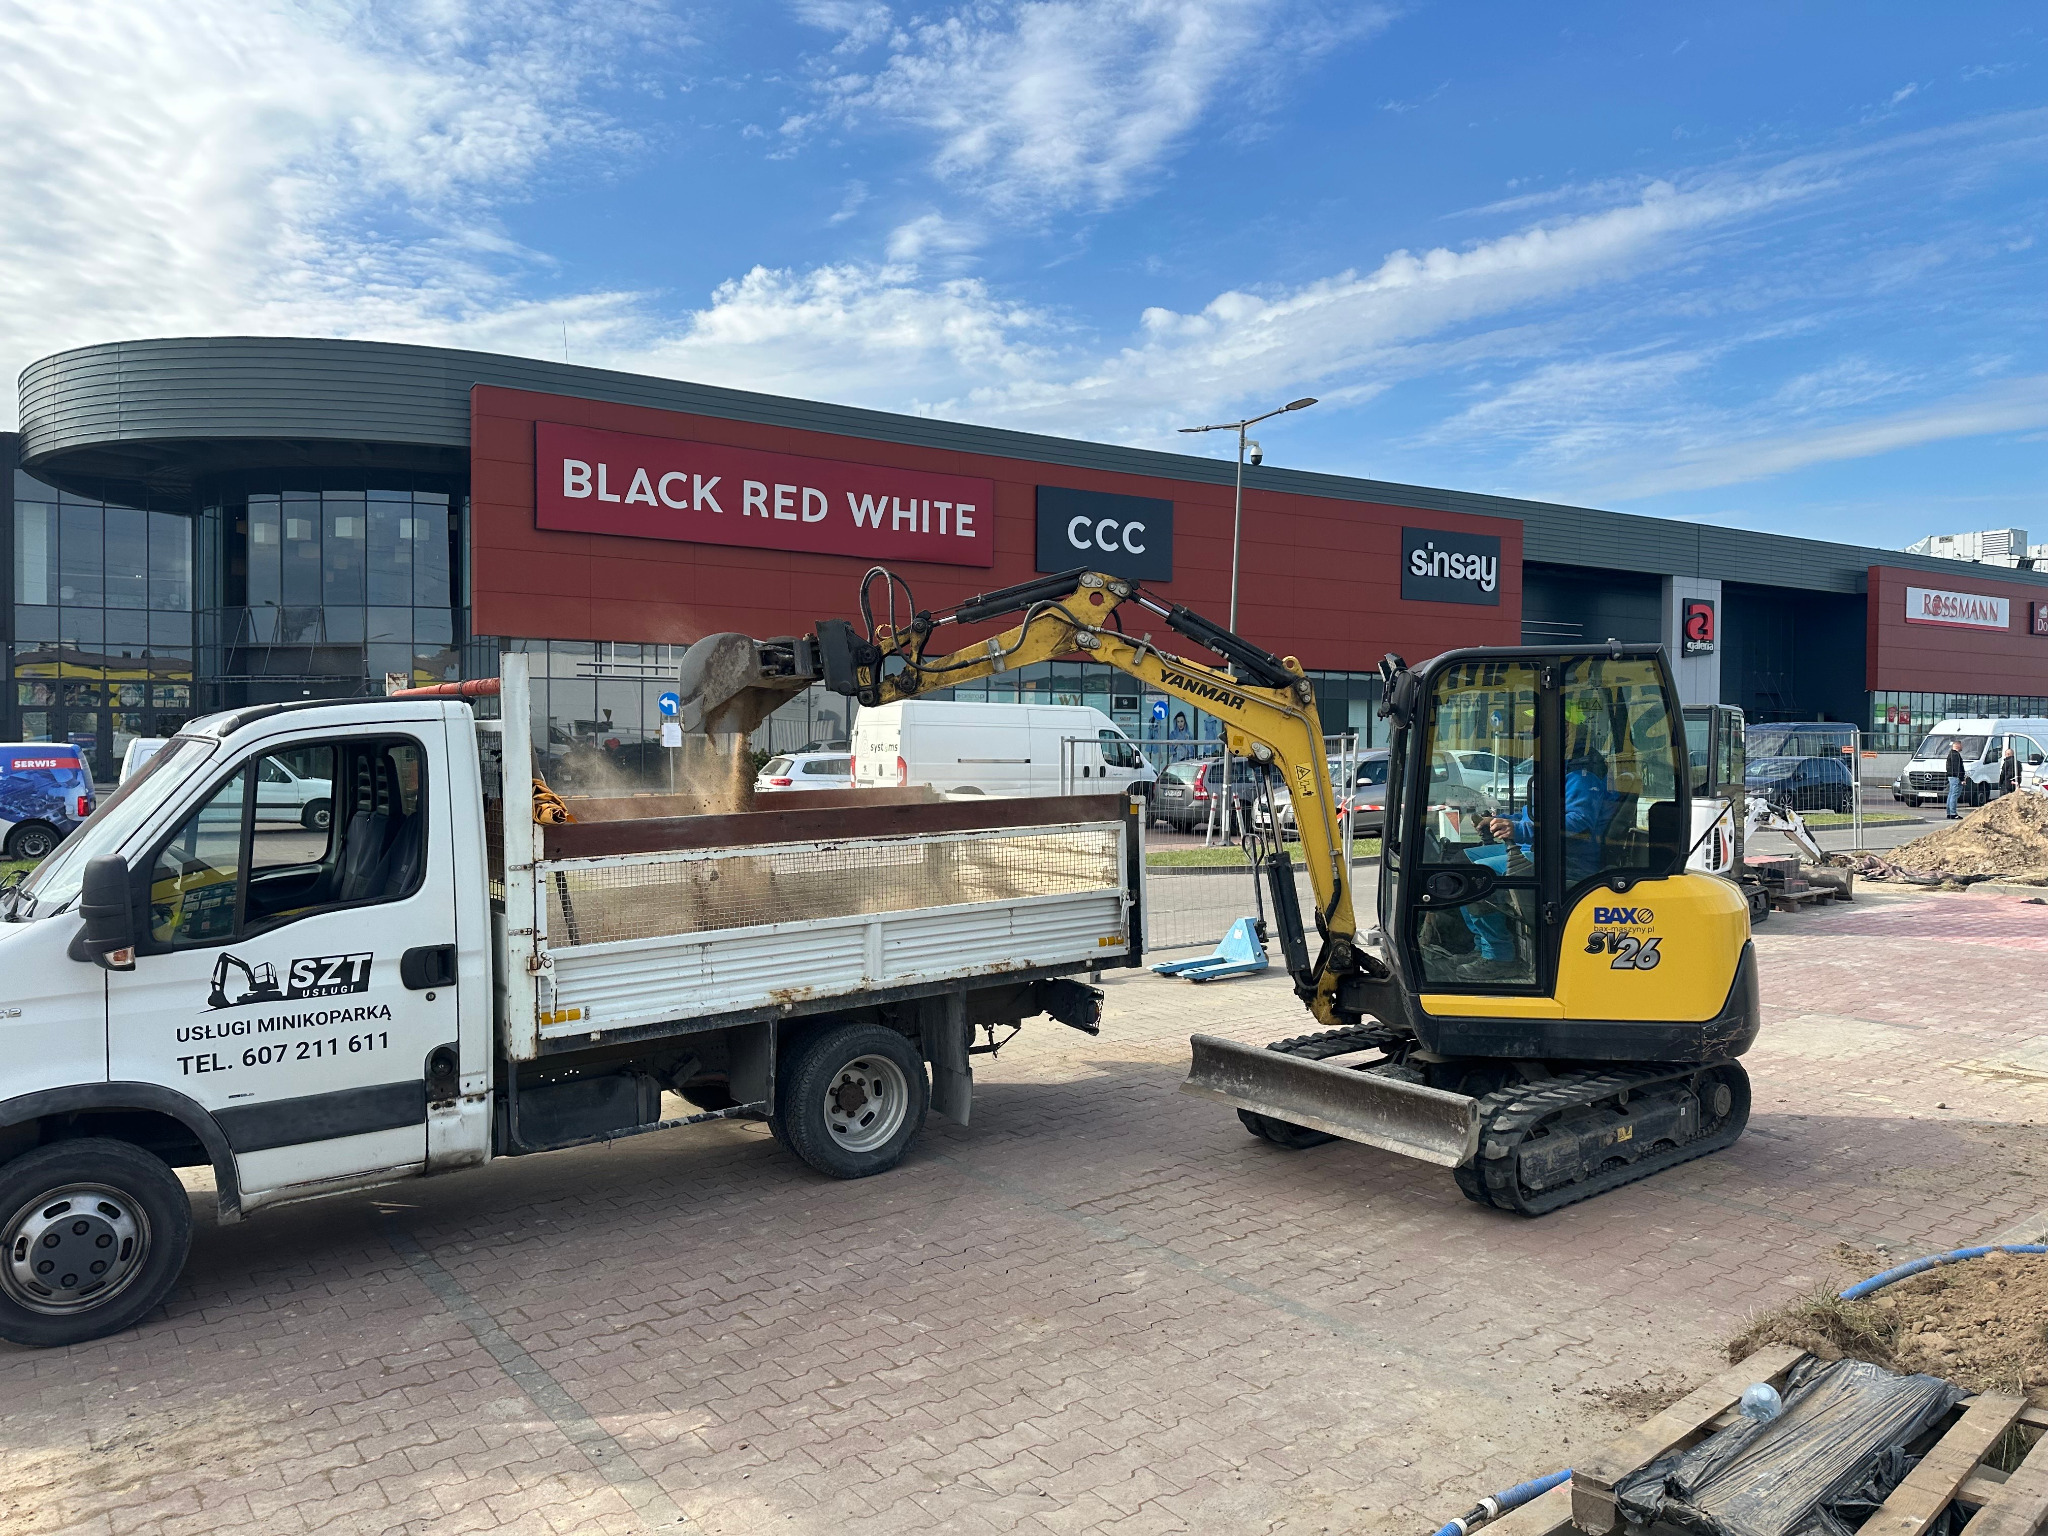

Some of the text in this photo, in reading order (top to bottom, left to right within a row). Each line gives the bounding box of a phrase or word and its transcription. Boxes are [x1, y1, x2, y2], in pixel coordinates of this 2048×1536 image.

[563, 459, 977, 538] BLACK RED WHITE
[1067, 514, 1147, 555] CCC
[1410, 541, 1498, 593] sinsay
[1922, 593, 1999, 623] ROSSMANN
[1686, 640, 1714, 653] galeria
[1160, 669, 1246, 710] YANMAR
[14, 759, 57, 768] SERWIS
[1594, 907, 1639, 924] BAX
[291, 953, 372, 989] SZT
[302, 985, 355, 998] USŁUGI
[176, 1004, 393, 1043] USŁUGI MINIKOPARKĄ
[177, 1031, 389, 1076] TEL. 607 211 611
